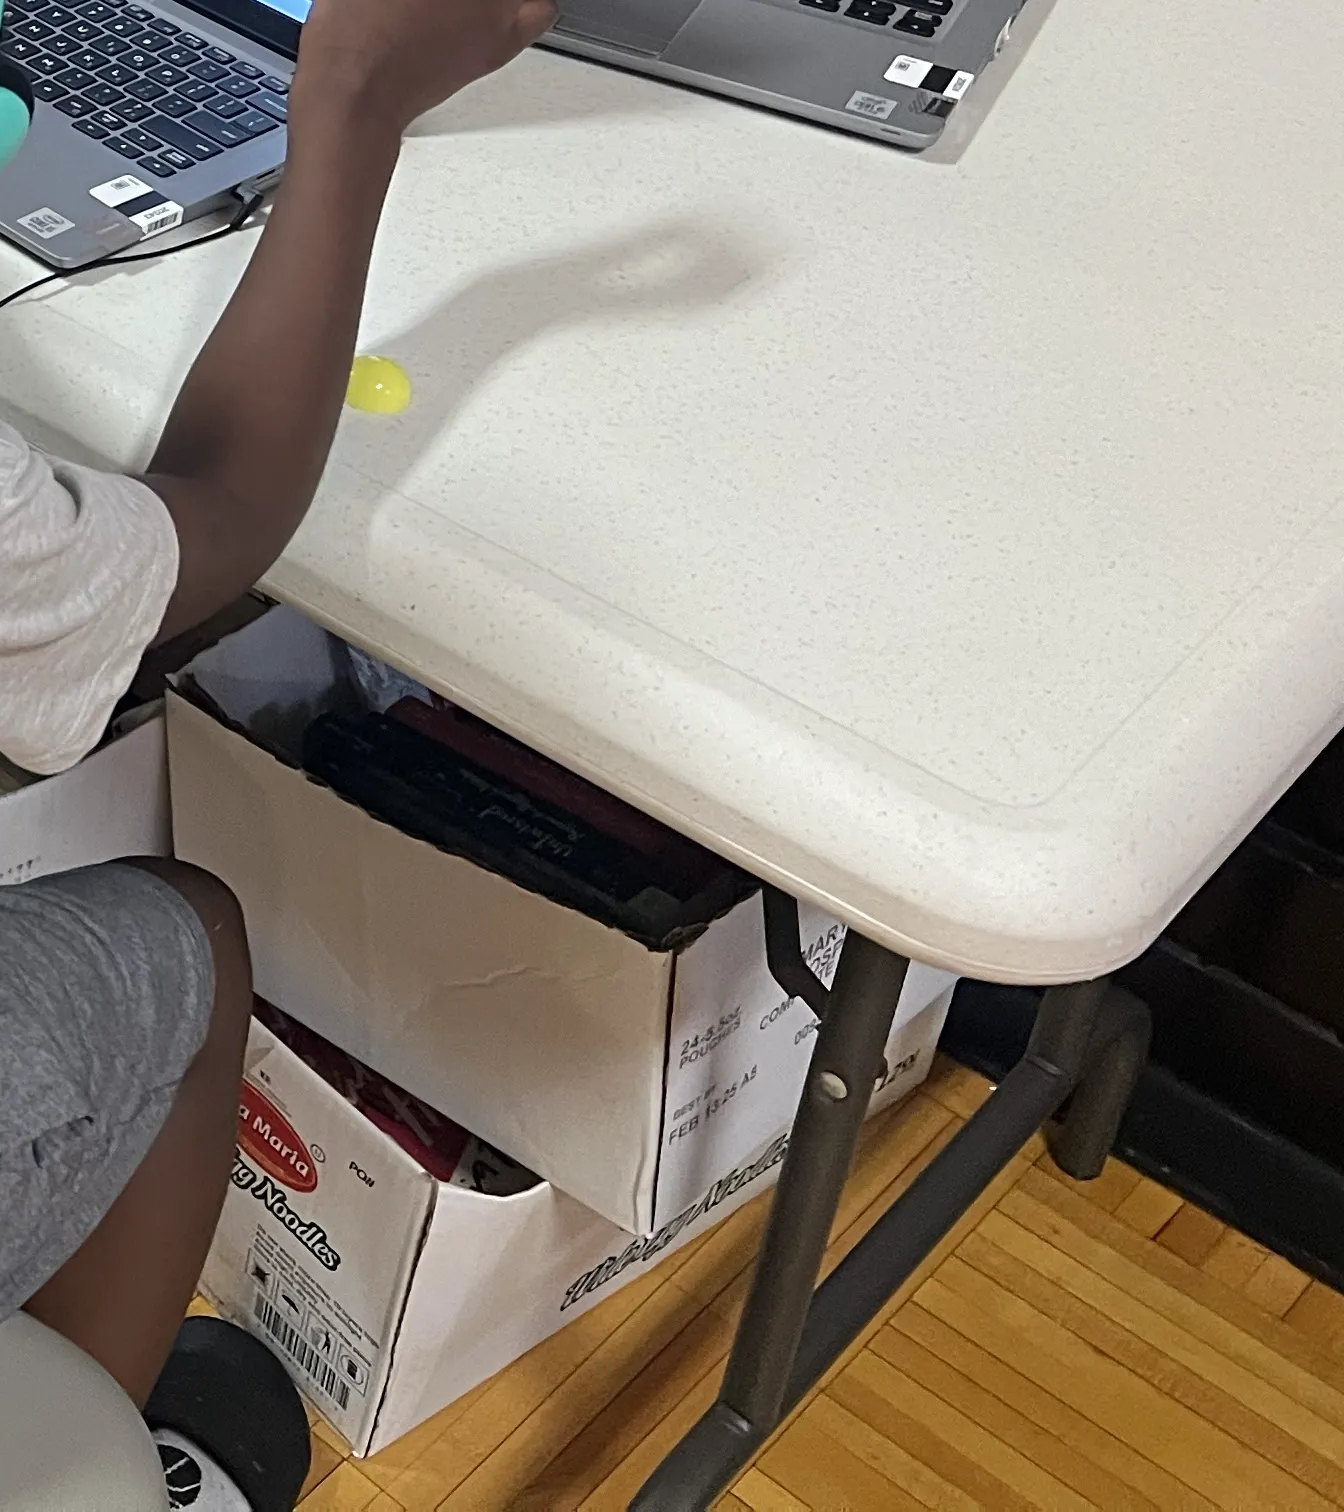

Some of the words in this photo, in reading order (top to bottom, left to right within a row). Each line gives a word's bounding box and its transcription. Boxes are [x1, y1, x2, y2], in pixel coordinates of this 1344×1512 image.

[252, 1115, 310, 1179] Maria
[668, 1113, 700, 1146] FEB
[255, 1178, 340, 1270] Noodles
